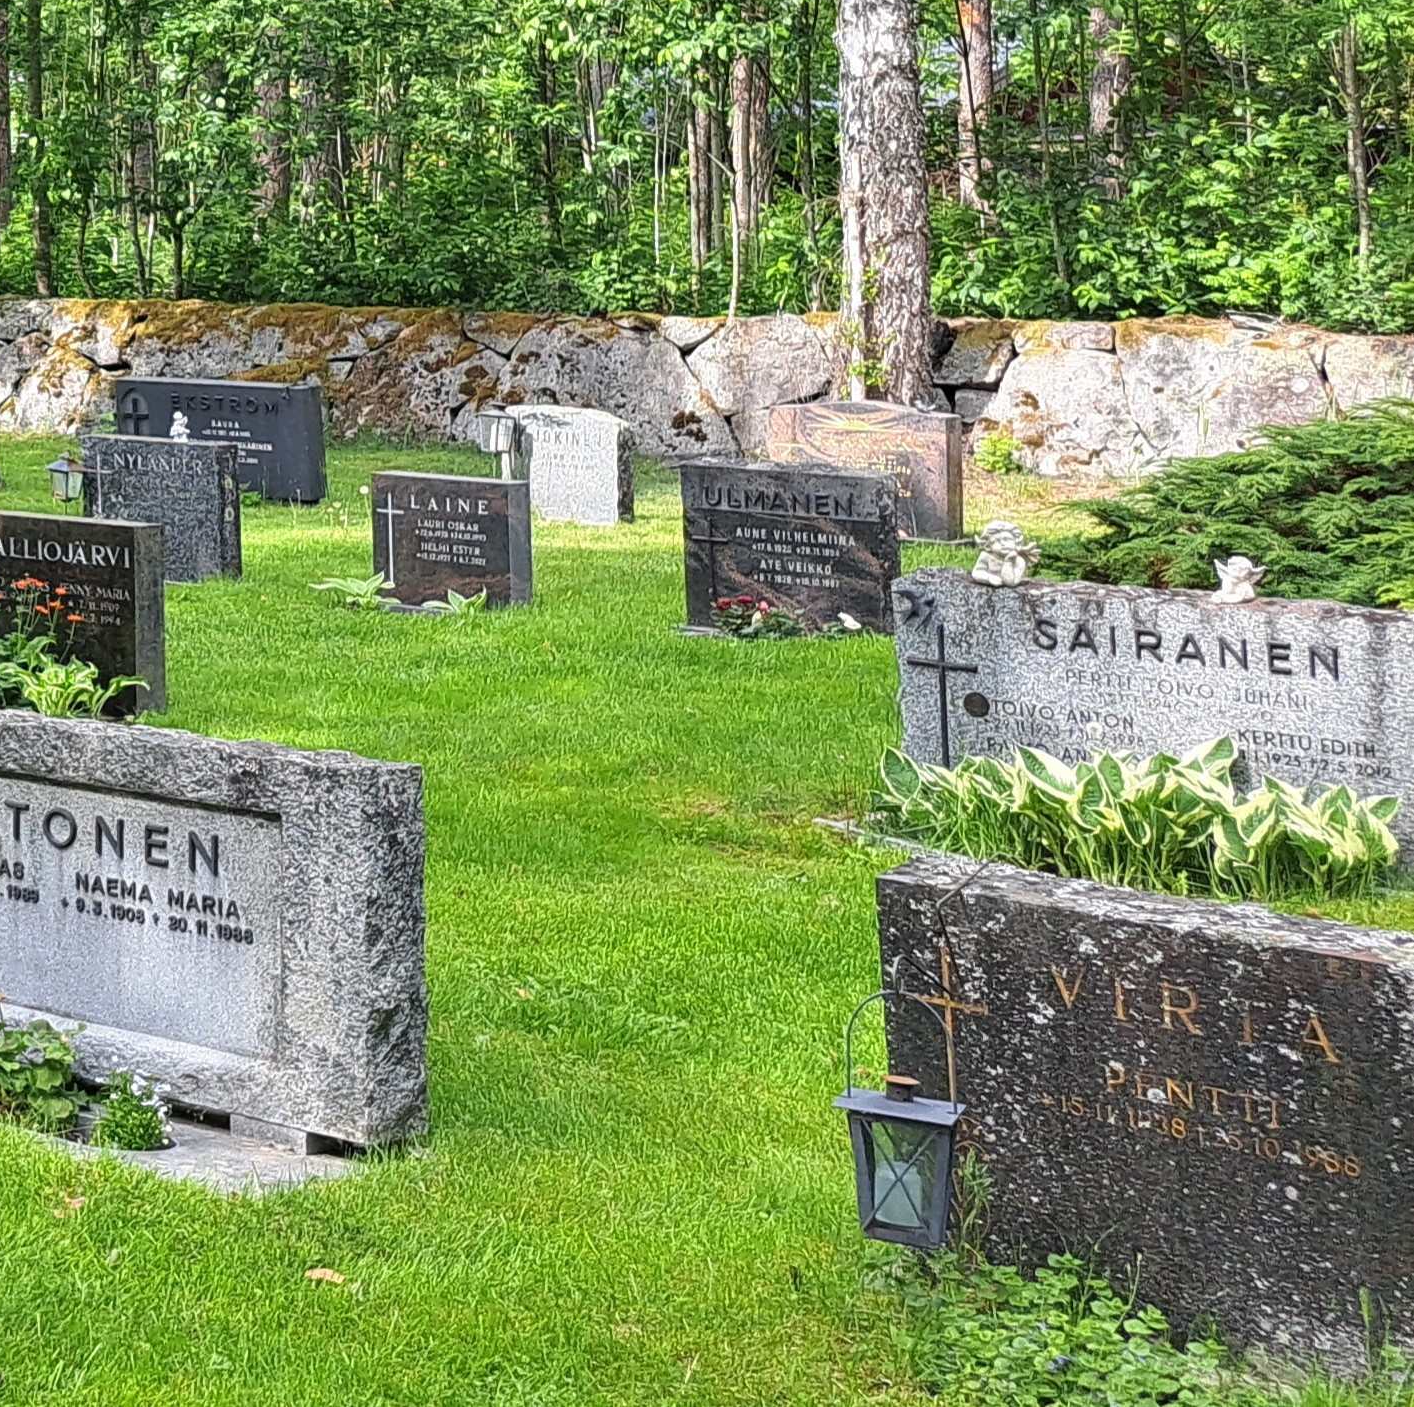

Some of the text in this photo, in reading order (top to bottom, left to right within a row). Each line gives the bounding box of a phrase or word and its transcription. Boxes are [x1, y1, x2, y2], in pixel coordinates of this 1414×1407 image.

[171, 392, 279, 415] EKSTRÖM
[114, 453, 202, 475] NYLANDER
[410, 494, 489, 515] LAINE
[703, 486, 854, 517] ULMANEN
[417, 519, 479, 532] LAURI OSKAR
[736, 527, 856, 547] AUNE VILHELMIINA
[788, 561, 832, 576] VEIKKO
[96, 586, 131, 602] MARIA
[1033, 618, 1340, 682] SAIRANEN
[1065, 668, 1132, 691] PERTTI
[1232, 688, 1310, 711] JUHANI
[991, 699, 1135, 731] TOIVO ANTON
[1237, 728, 1377, 760] KERTTU EDITH
[75, 872, 242, 922] NAEMA MARIA
[1046, 962, 1344, 1065] VIRTA
[1101, 1060, 1282, 1131] PENTTI
